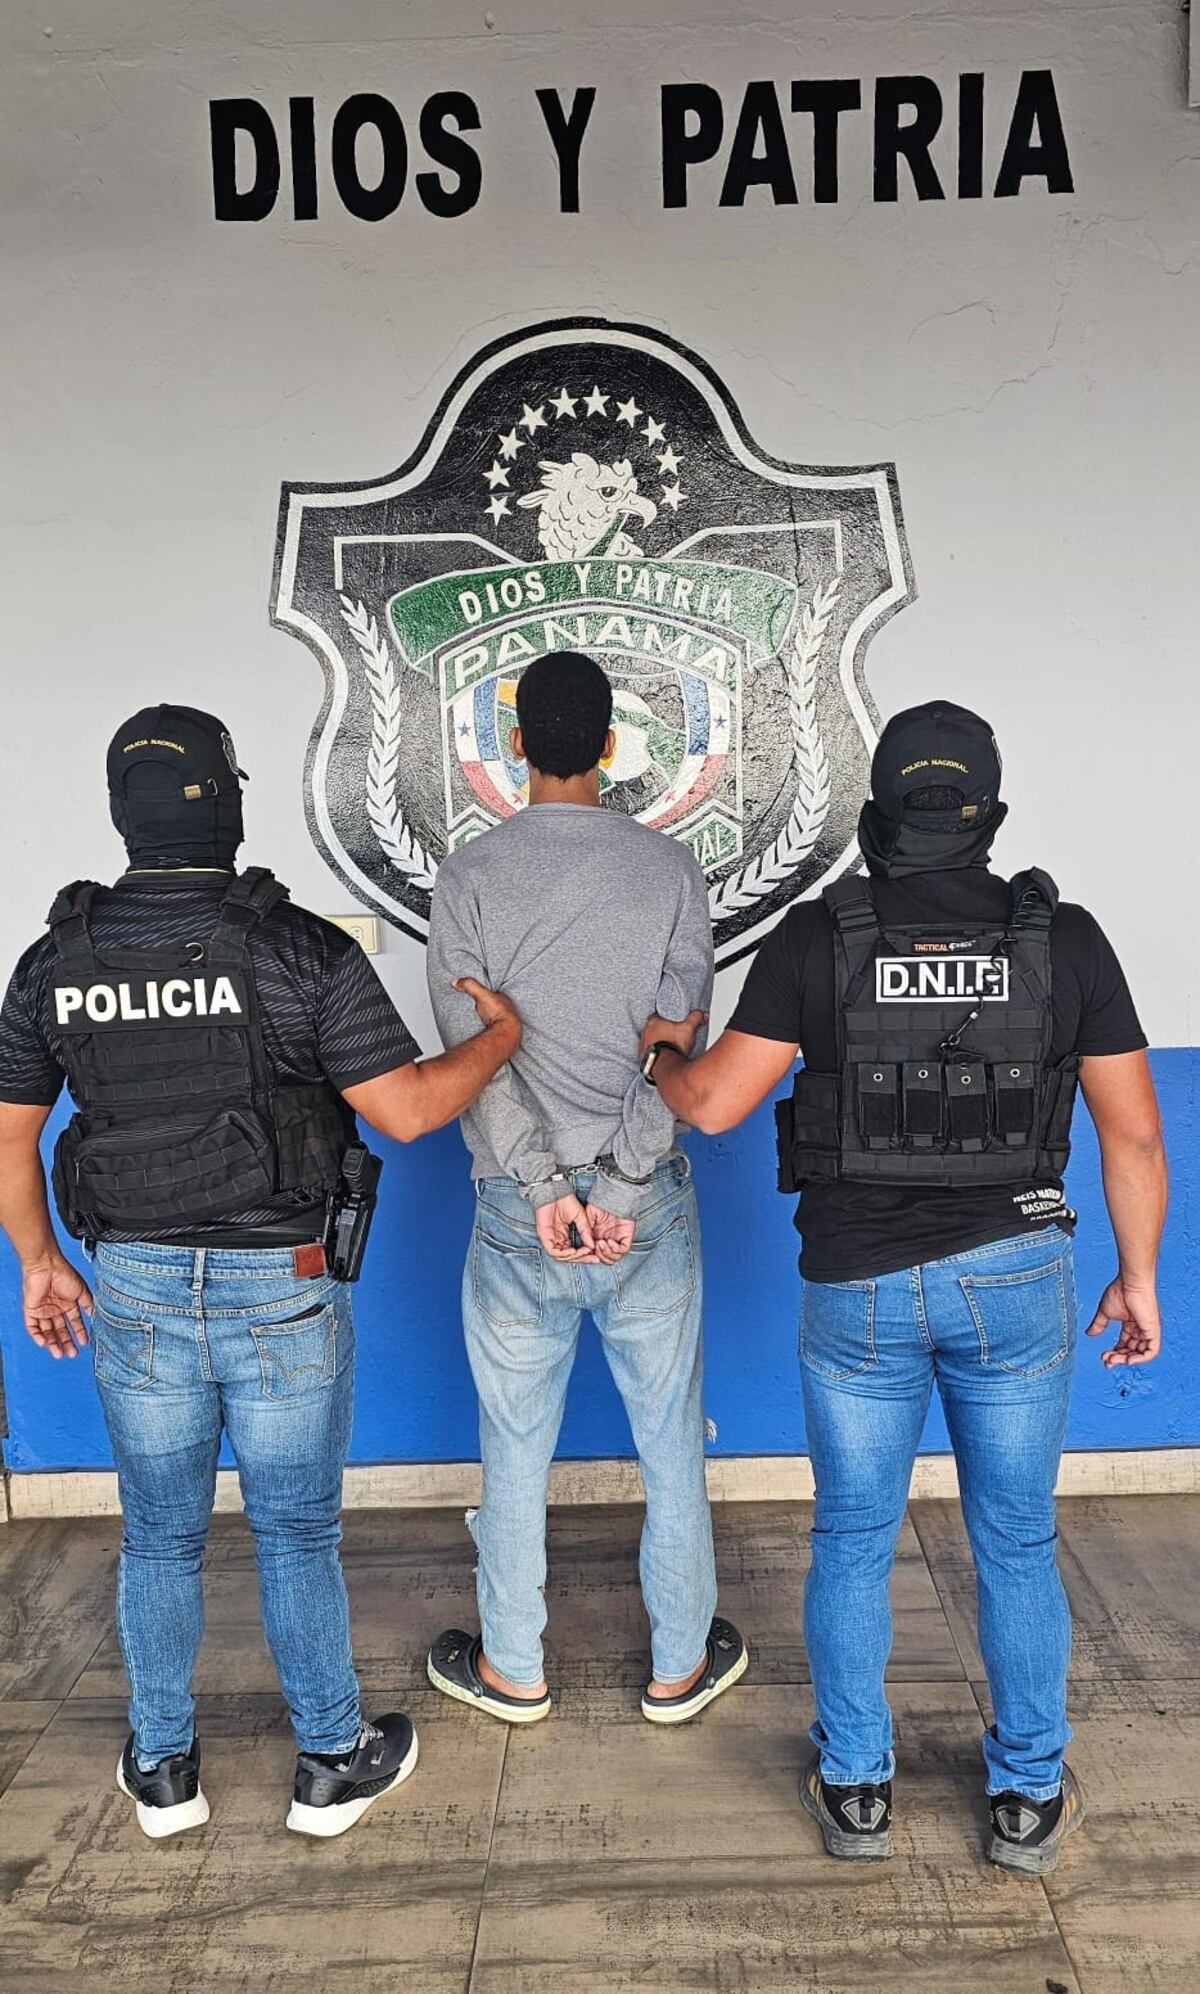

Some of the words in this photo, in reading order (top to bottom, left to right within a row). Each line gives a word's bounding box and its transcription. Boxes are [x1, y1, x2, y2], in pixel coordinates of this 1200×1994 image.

[209, 91, 483, 222] DIOS
[536, 87, 598, 214] Y
[660, 70, 1076, 209] PATRIA
[457, 570, 546, 625] DIOS
[573, 562, 592, 595] Y
[615, 563, 733, 621] PATRIA
[454, 615, 728, 690] PANAMA
[931, 759, 969, 774] NACIONAL
[54, 976, 243, 1026] POLICIA
